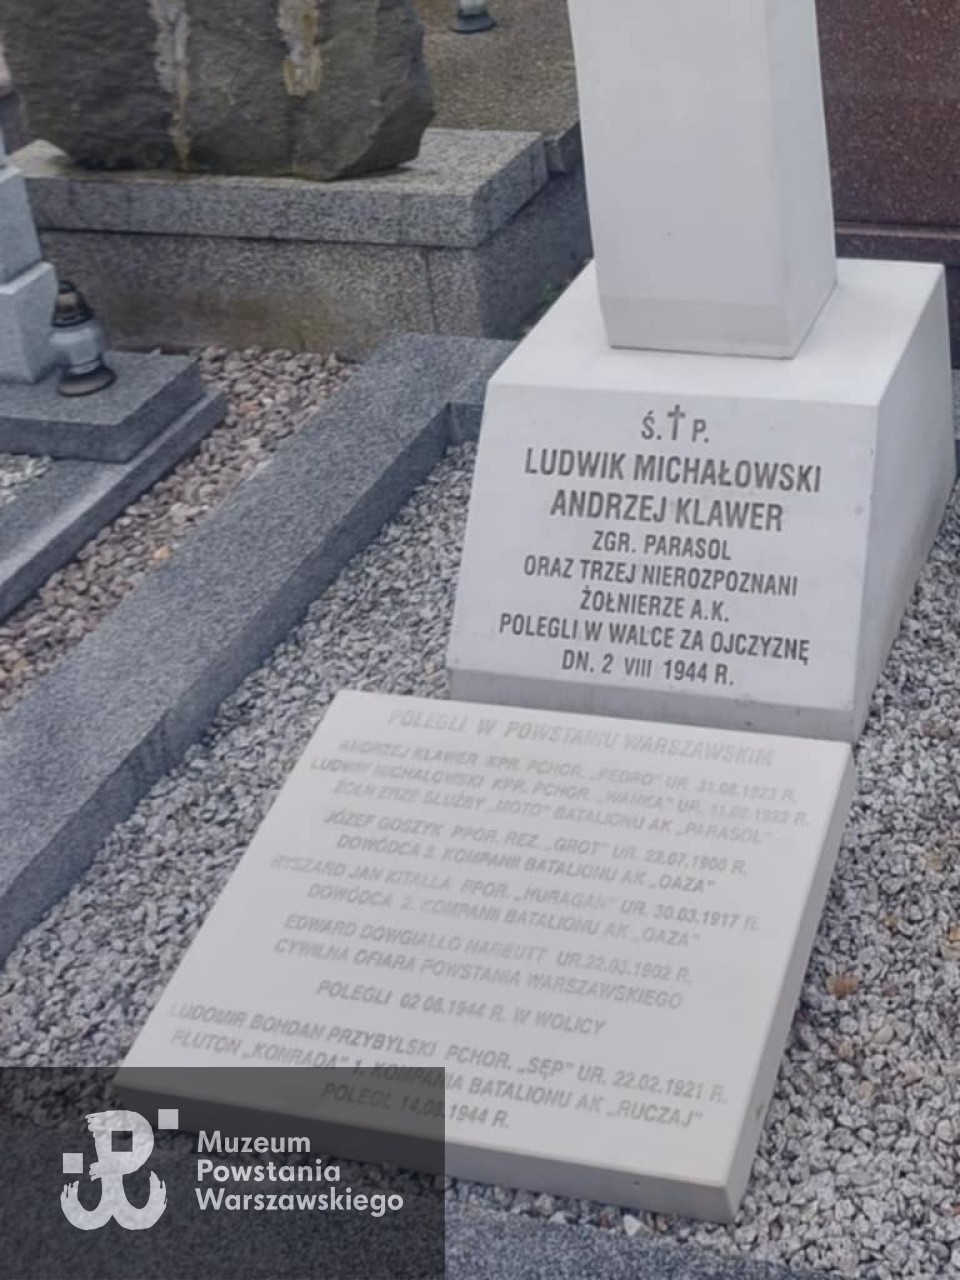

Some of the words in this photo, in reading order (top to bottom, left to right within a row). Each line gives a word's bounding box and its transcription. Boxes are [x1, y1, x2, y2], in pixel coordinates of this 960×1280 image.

[640, 410, 662, 441] Ś.
[691, 418, 710, 443] P.
[524, 447, 625, 480] LUDWIK
[633, 454, 821, 493] MICHAŁOWSKI
[550, 490, 666, 523] ANDRZEJ
[675, 498, 783, 532] KLAWER
[591, 530, 637, 554] ZGR.
[644, 534, 731, 561] PARASOL
[523, 556, 573, 579] ORAZ
[579, 559, 636, 585] TRZEJ
[642, 564, 798, 597] NIEROZPOZNANI
[579, 589, 684, 619] ŻOŁNIERZE
[690, 600, 729, 622] A.K.
[499, 613, 578, 641] POLEGLI
[583, 620, 603, 642] W
[609, 623, 674, 649] WALCE
[680, 629, 704, 651] ZA
[710, 633, 811, 666] OJCZYZNĘ
[562, 649, 595, 673] DN.
[601, 652, 613, 674] 2
[624, 658, 651, 678] VIII
[664, 659, 708, 683] 1944
[714, 662, 734, 687] R.
[387, 709, 471, 732] POLEGLI
[477, 719, 497, 735] W
[504, 720, 617, 749] POWSTANIU
[623, 735, 775, 766] WARSZAWSKIM
[647, 818, 672, 833] AK
[336, 833, 421, 857] DOWÓDCA
[523, 857, 618, 882] BATALIONU
[620, 869, 647, 887] AK
[347, 865, 384, 881] JAN
[283, 913, 358, 937] EDWARD
[305, 883, 394, 908] DOWÓDCA
[503, 908, 601, 935] BATALIONU
[602, 922, 631, 940] AK
[274, 937, 351, 962] CYWILNA
[352, 949, 417, 972] OFIARA
[419, 958, 521, 986] POWSTANIA
[526, 971, 683, 1010] WARSZAWSKIEGO
[316, 979, 394, 1005] POLEGLI
[513, 1007, 531, 1025] W
[535, 1009, 607, 1036] WOLICY
[168, 1001, 249, 1027] LUDOMIR
[249, 1014, 326, 1040] BOHDAN
[326, 1027, 437, 1058] PRZYBYLSKI
[444, 1044, 512, 1071] PCHOR.
[577, 1064, 607, 1085] UR.
[612, 1070, 705, 1100] 22.02.1921
[170, 1029, 243, 1055] PLUTON
[370, 1062, 463, 1091] KOMPANIA
[468, 1077, 573, 1108] BATALIONU
[574, 1094, 605, 1114] AK
[491, 1110, 510, 1130] R.
